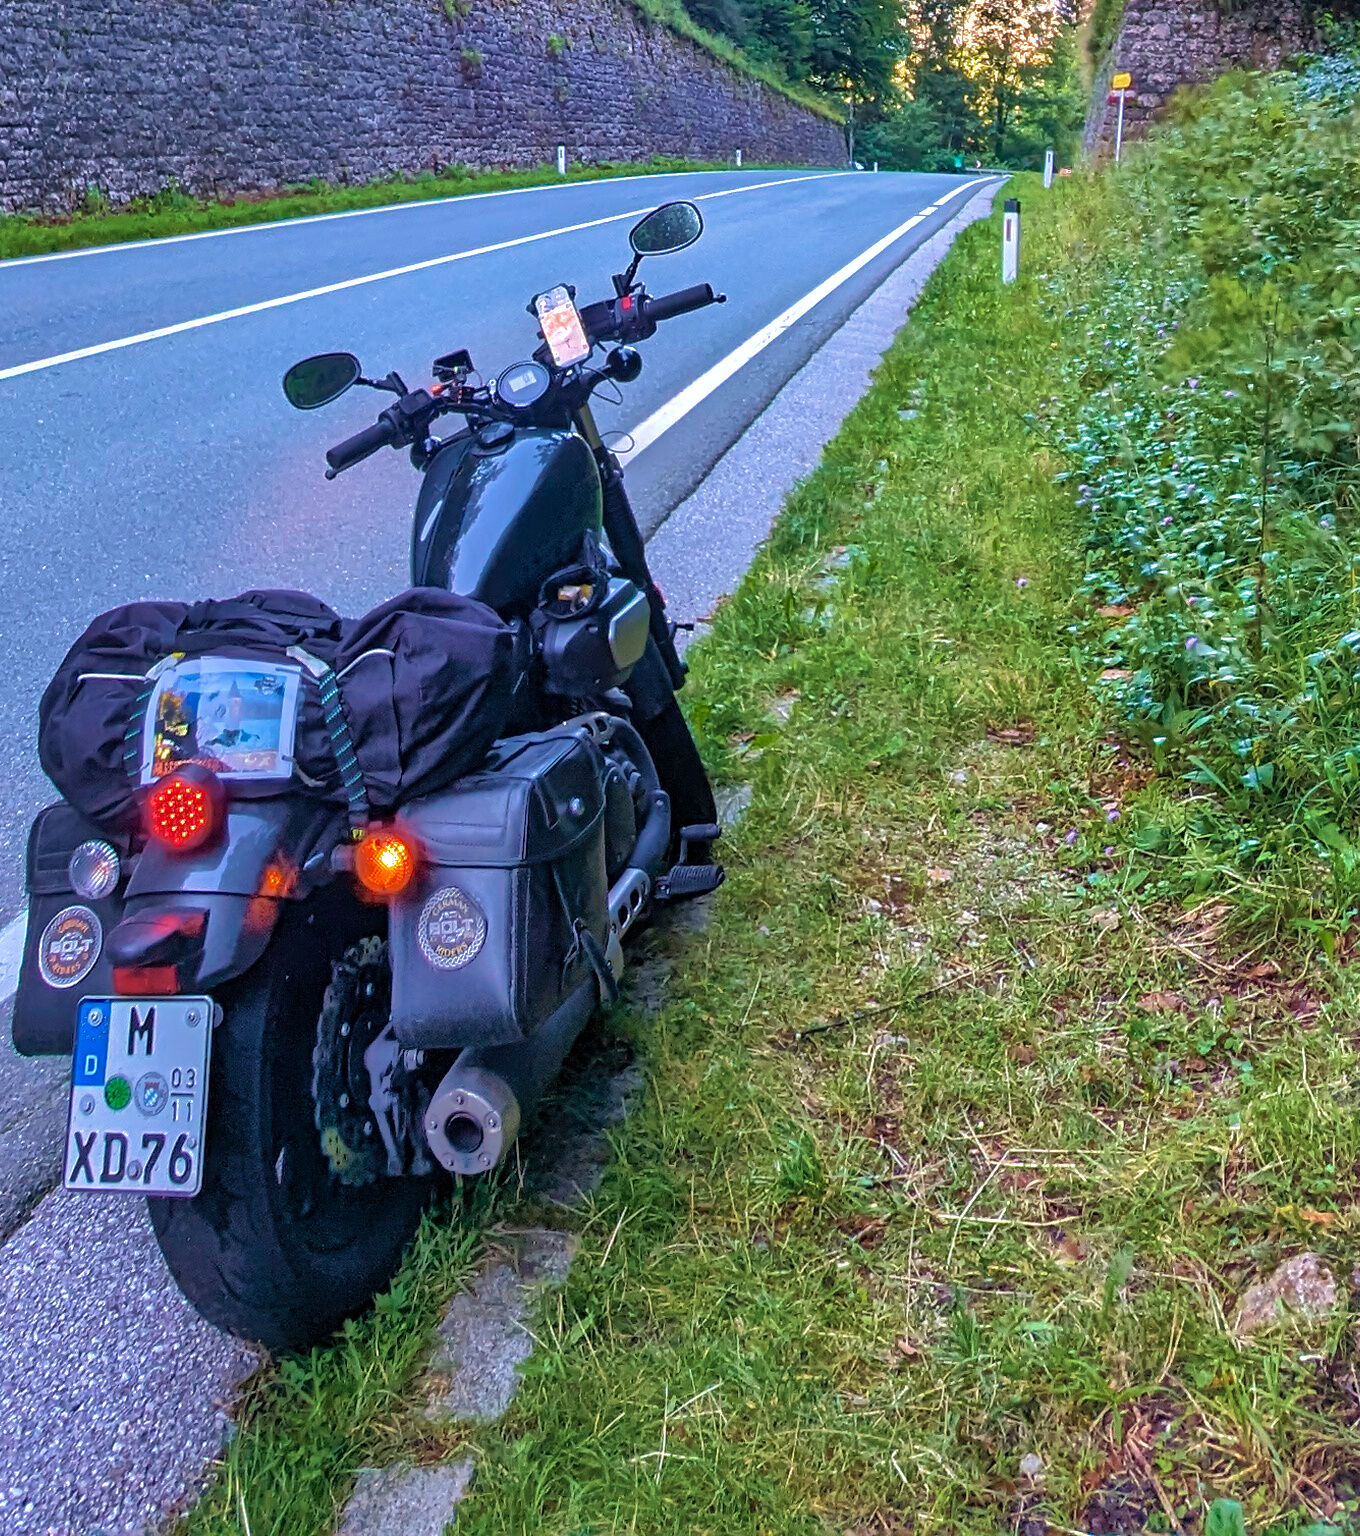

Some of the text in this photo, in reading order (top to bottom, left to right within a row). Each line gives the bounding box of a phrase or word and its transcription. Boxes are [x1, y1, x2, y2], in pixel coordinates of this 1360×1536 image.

[127, 1006, 157, 1055] M
[84, 1055, 98, 1076] D
[171, 1068, 197, 1088] 03
[171, 1099, 194, 1122] 11
